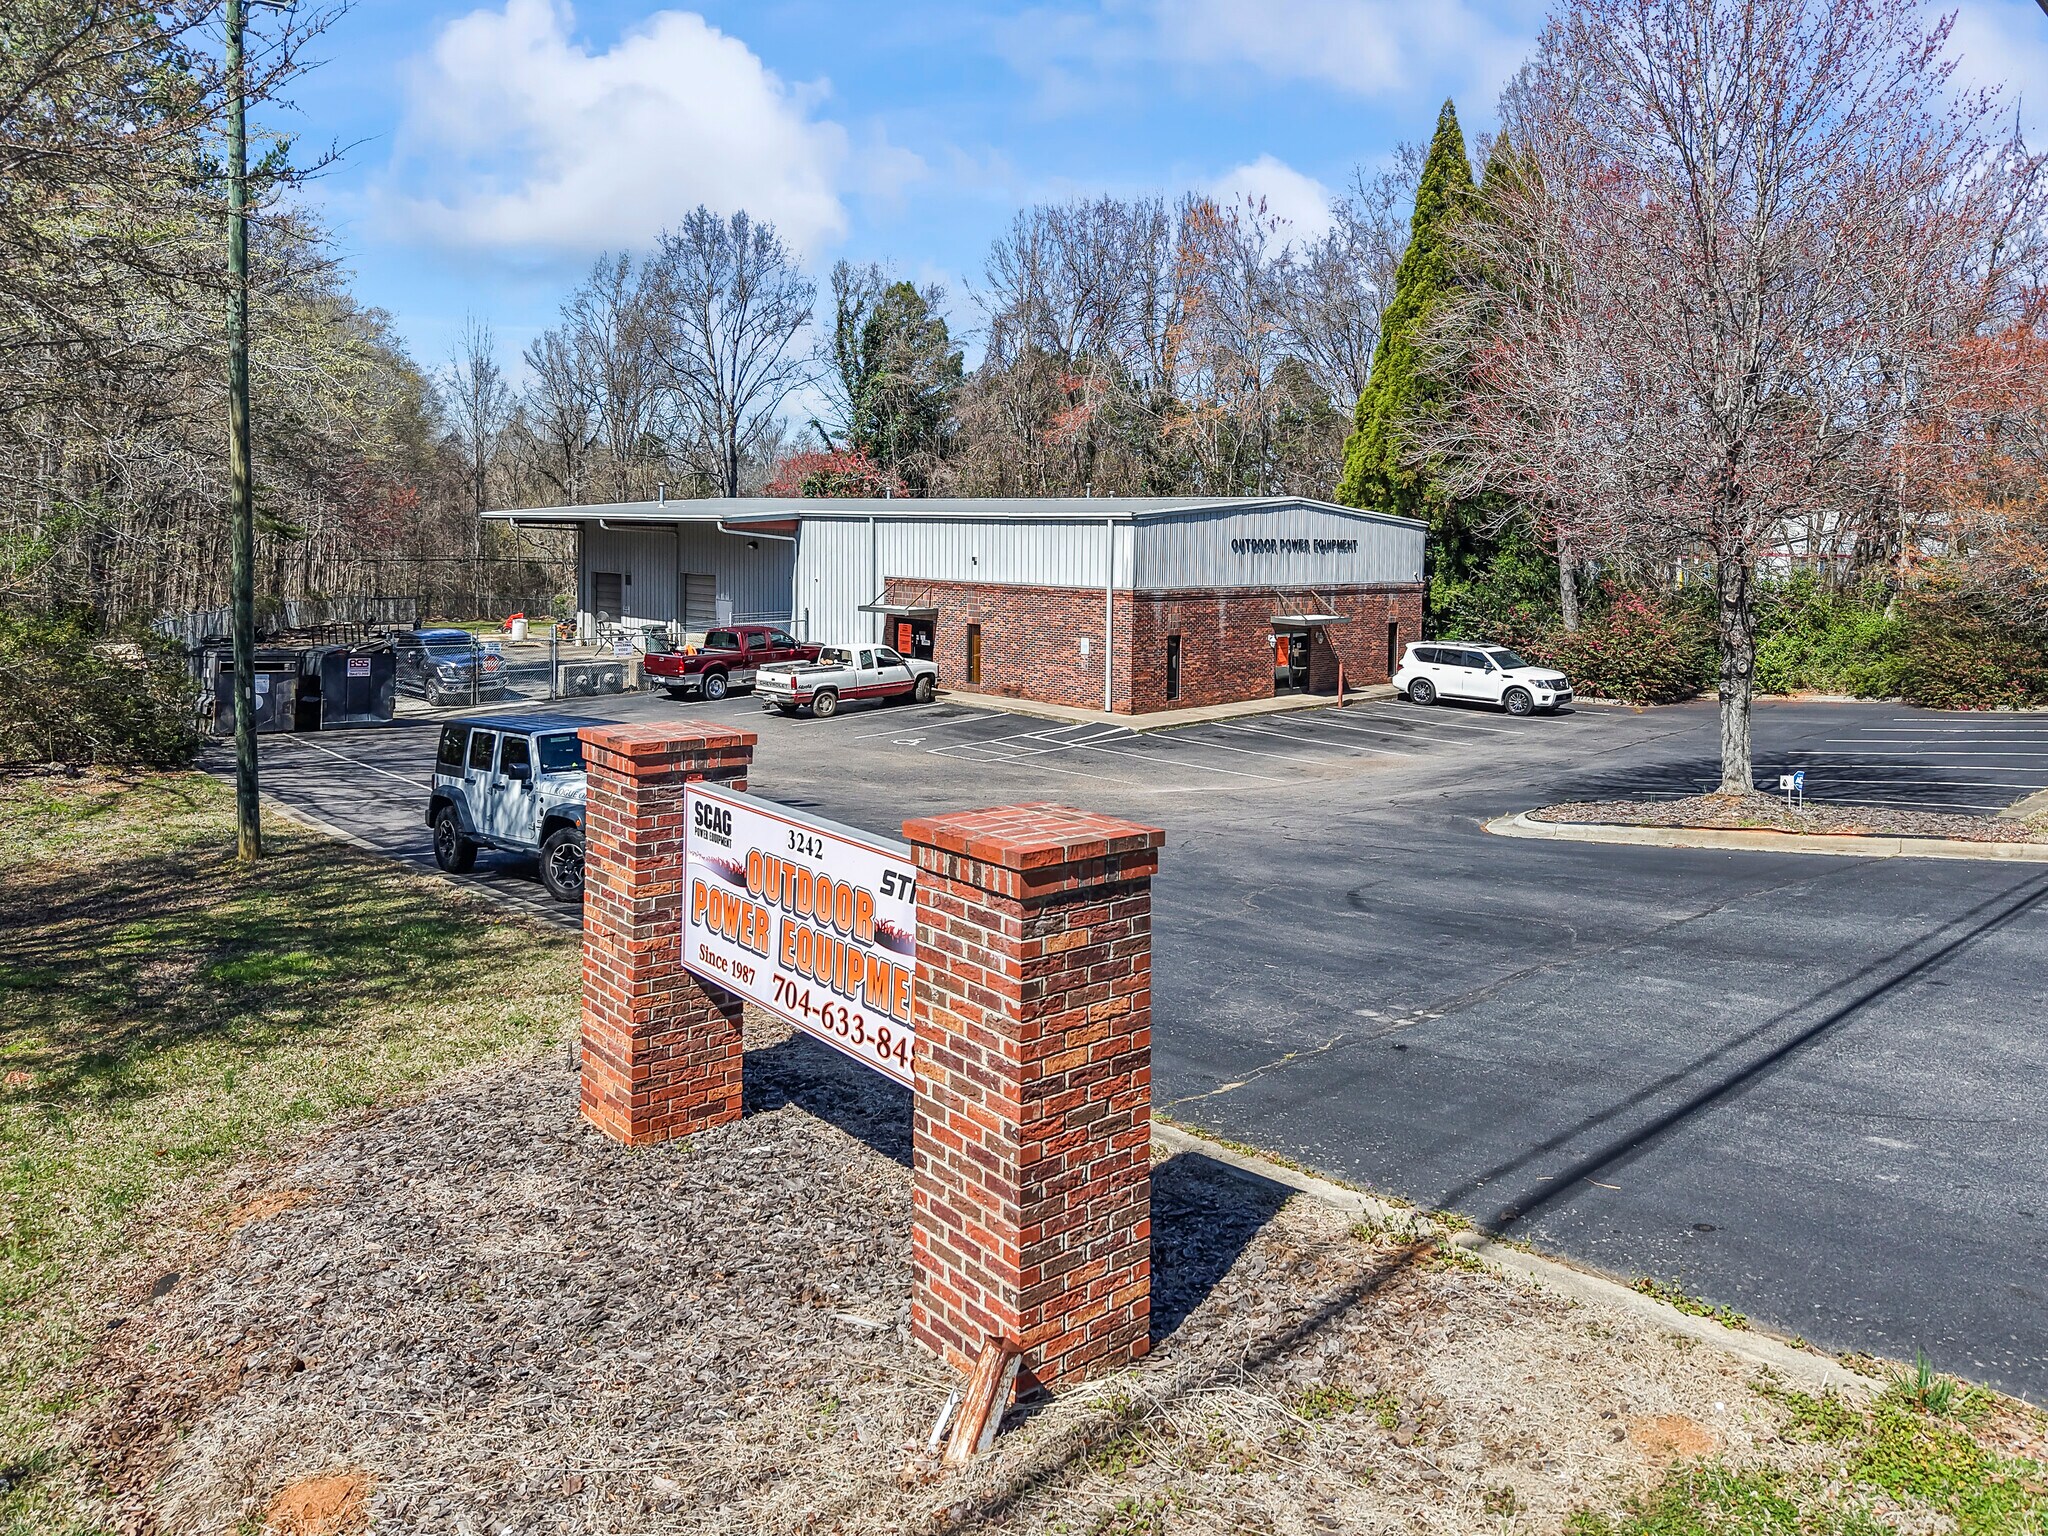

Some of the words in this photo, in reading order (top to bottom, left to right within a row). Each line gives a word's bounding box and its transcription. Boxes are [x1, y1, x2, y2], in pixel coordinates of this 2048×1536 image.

[1231, 539, 1278, 554] OUTDOOR
[1280, 539, 1311, 554] POWER
[1313, 539, 1358, 554] EQUIPMENT
[350, 659, 369, 667] BSS
[695, 800, 732, 837] SCAG
[694, 826, 709, 840] POWER
[709, 832, 732, 849] EQUIPMENT
[788, 829, 823, 860] 3242
[747, 847, 876, 947] OUTDOOR
[691, 877, 771, 958] POWER
[779, 914, 916, 1031] EQUIPME
[699, 944, 728, 973] Since
[731, 960, 756, 986] 1987
[772, 973, 916, 1074] 704-633-84
